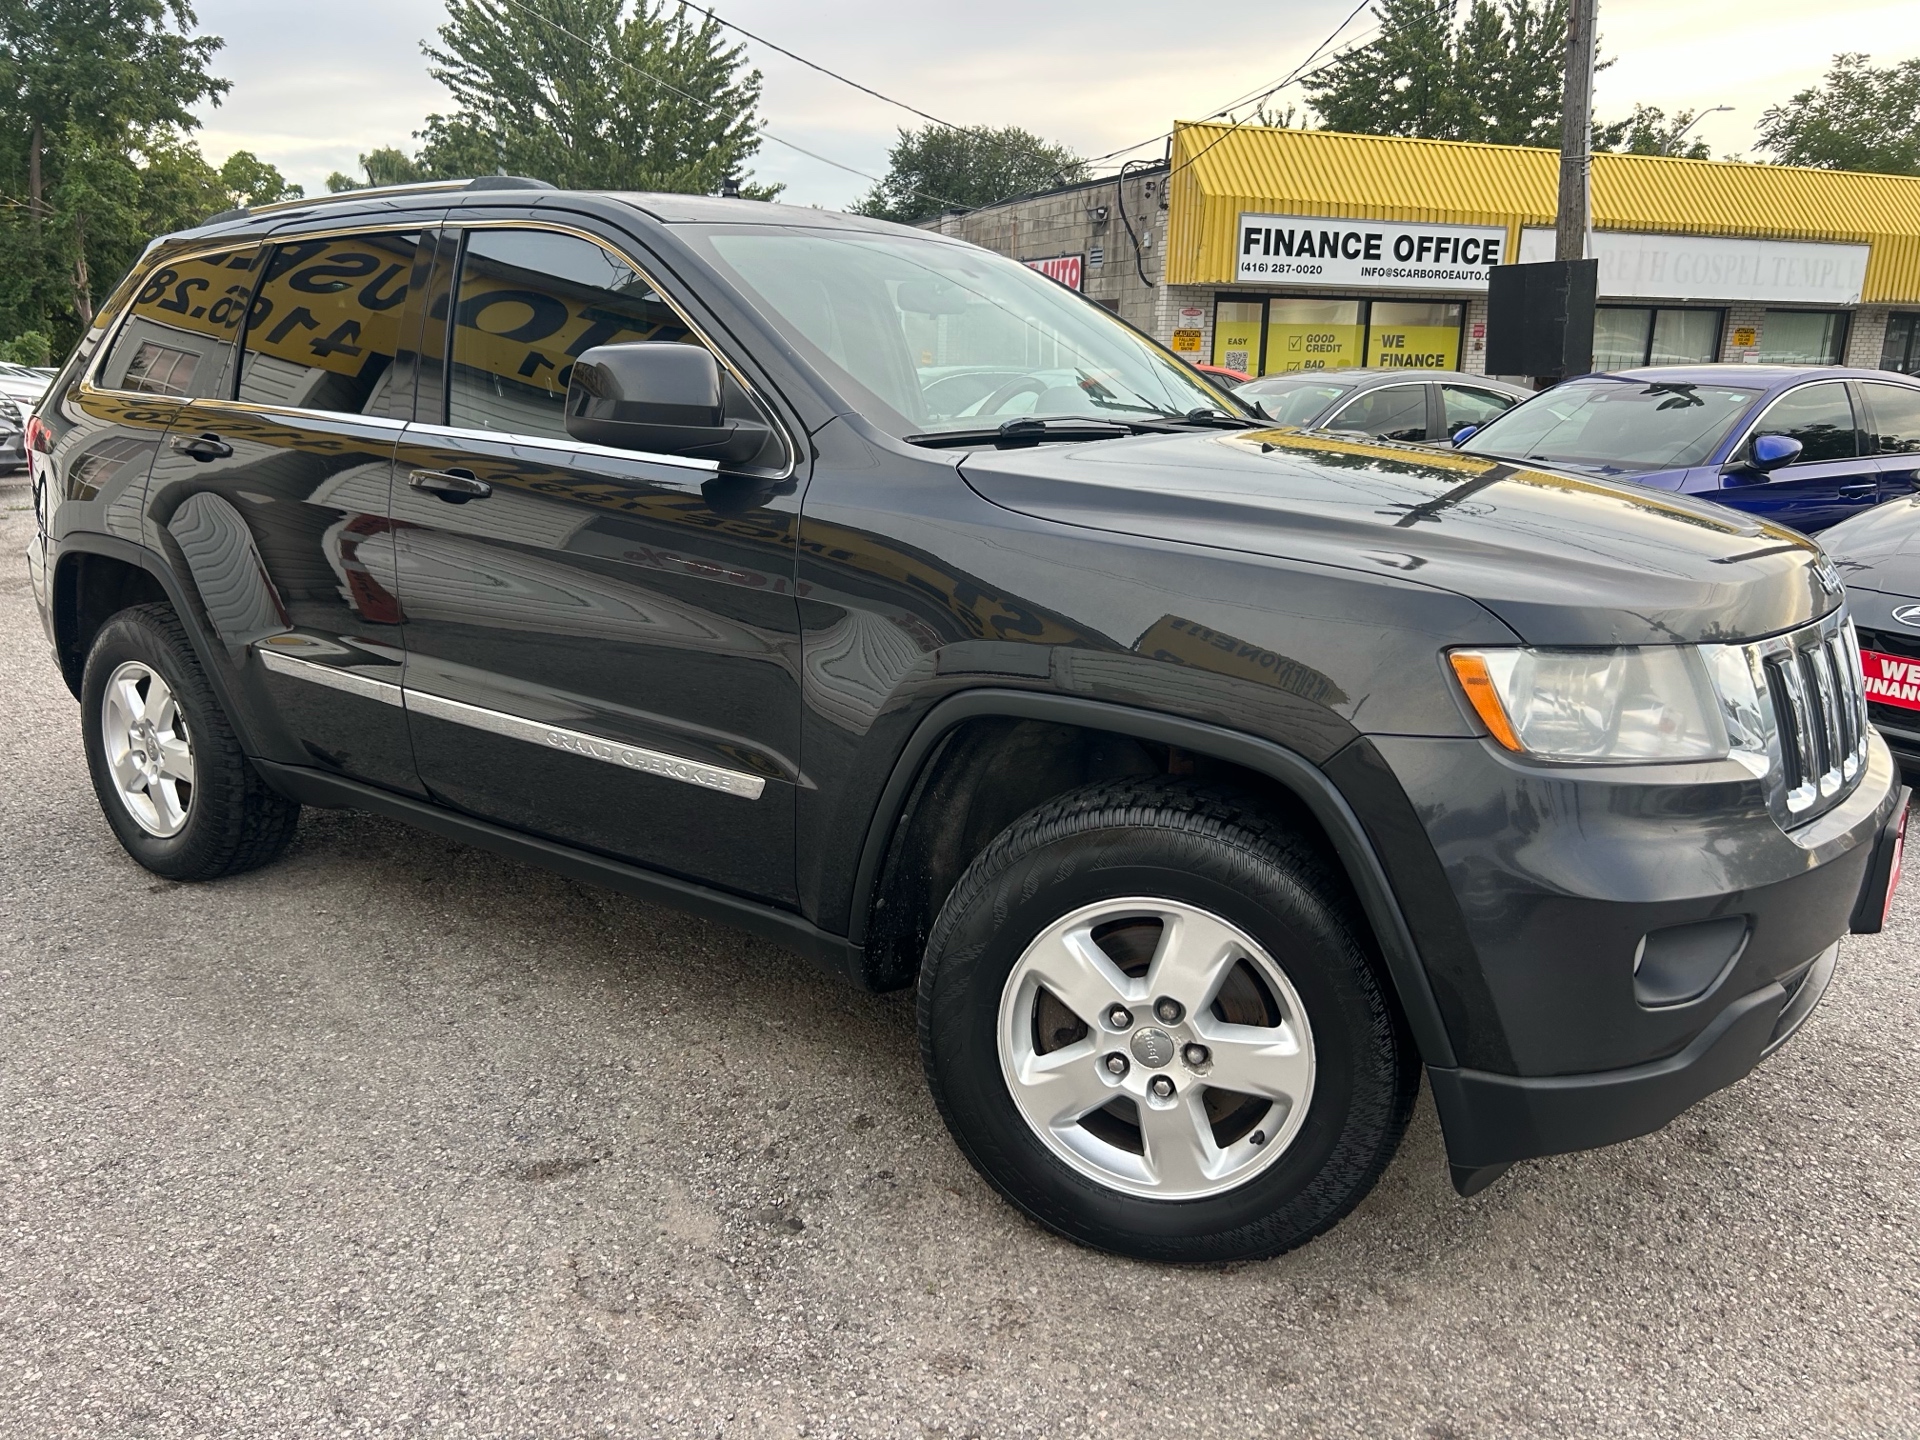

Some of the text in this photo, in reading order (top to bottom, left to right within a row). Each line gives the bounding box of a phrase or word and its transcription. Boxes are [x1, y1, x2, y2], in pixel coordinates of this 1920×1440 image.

[1242, 227, 1500, 265] FINANCE OFFICE
[1241, 262, 1323, 275] (416) 287-0020
[1361, 267, 1490, 281] INFO@SCARBOROEAUTO.C
[1673, 251, 1765, 287] GOSPEL
[1306, 334, 1335, 343] GOOD
[1382, 334, 1405, 348] WE
[1305, 344, 1342, 353] CREDIT
[1304, 360, 1325, 369] BAD
[1380, 353, 1445, 367] FINANCE
[1880, 658, 1920, 685] WE
[1863, 676, 1920, 703] INAN
[546, 731, 732, 791] GRAND CHEROKEE
